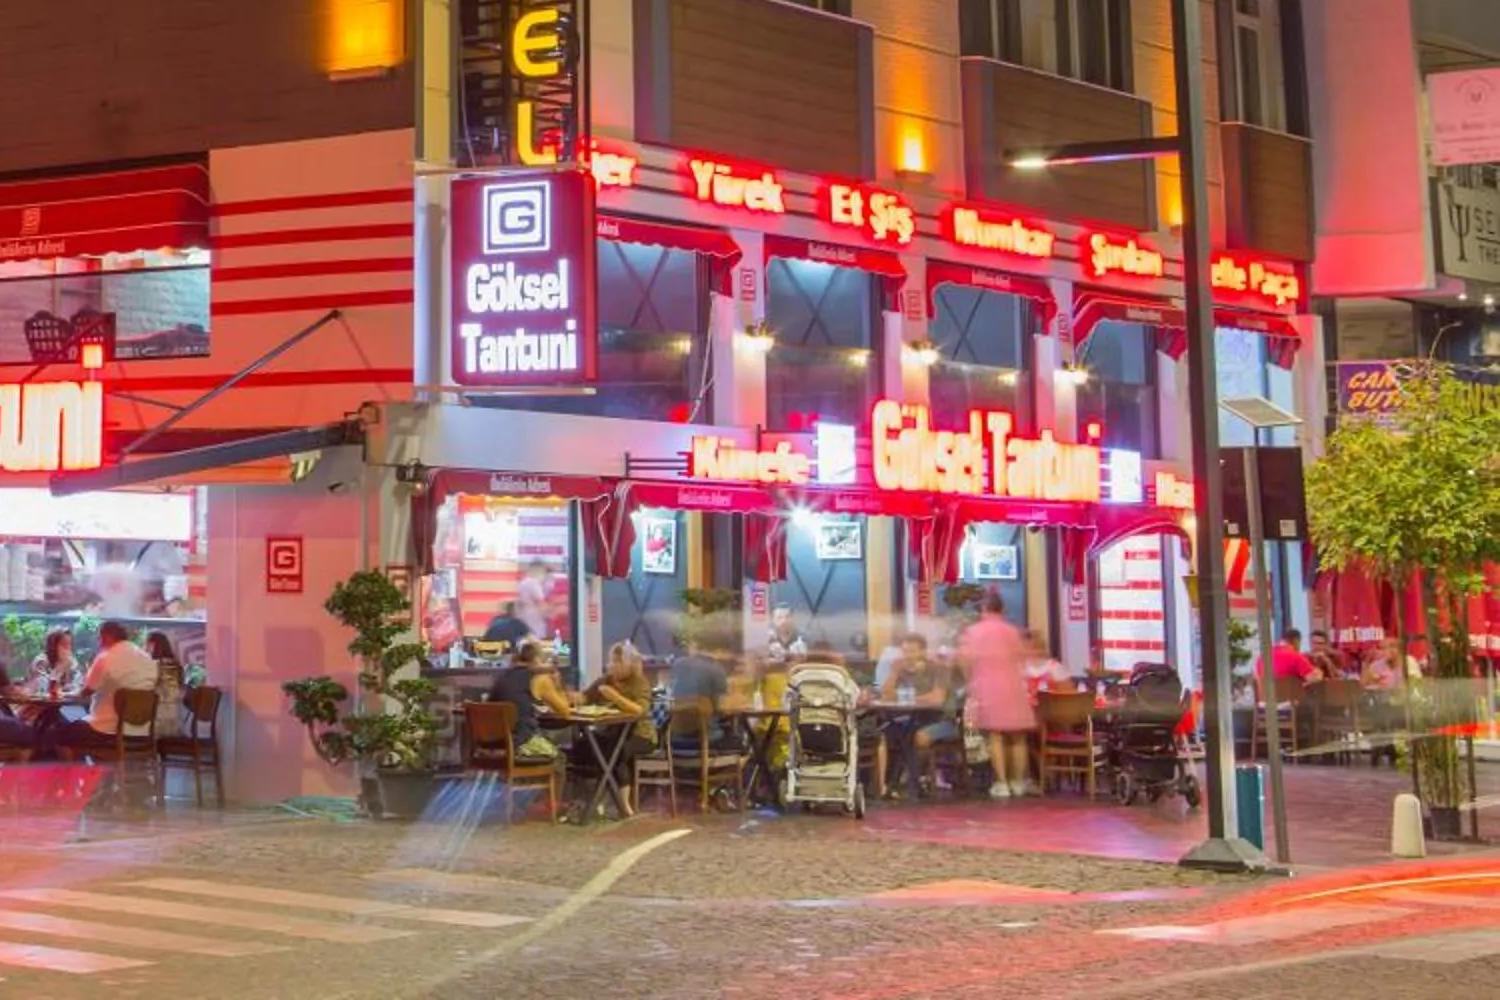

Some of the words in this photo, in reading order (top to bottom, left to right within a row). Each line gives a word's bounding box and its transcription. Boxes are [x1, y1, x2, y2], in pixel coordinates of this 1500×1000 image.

[499, 202, 540, 234] G
[690, 159, 785, 213] Yürek
[830, 184, 864, 227] Et
[1211, 257, 1247, 291] elle
[467, 259, 569, 313] Göksel
[461, 320, 577, 373] Tantuni
[693, 435, 811, 485] Künefe
[872, 398, 982, 495] Göksel
[987, 412, 1101, 502] Tantuni
